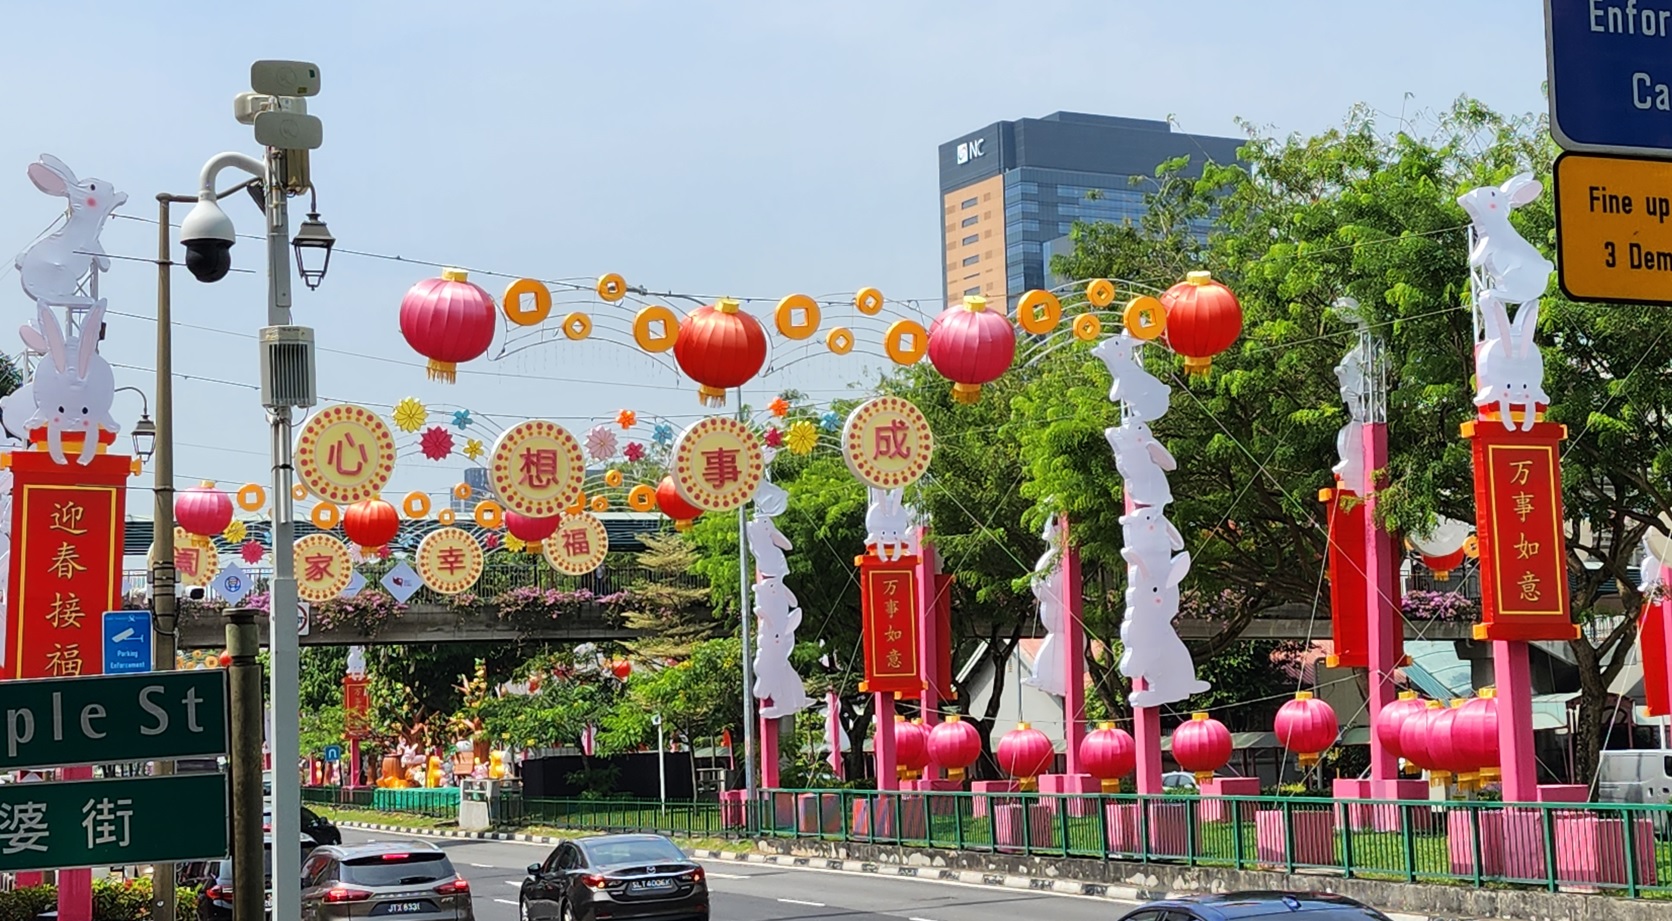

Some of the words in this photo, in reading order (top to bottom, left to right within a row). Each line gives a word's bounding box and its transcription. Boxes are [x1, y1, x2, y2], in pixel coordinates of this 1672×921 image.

[1589, 0, 1671, 37] Enfor
[1632, 72, 1671, 111] Ca
[1589, 186, 1633, 214] Fine
[1645, 196, 1670, 224] up
[1604, 241, 1616, 268] 3
[1629, 242, 1672, 271] Dem
[327, 431, 368, 476] 心
[518, 446, 560, 489] 想
[701, 447, 742, 490] 事
[873, 419, 911, 461] 成
[304, 553, 335, 582] 家
[437, 546, 466, 576] 幸
[561, 527, 590, 558] 福
[1509, 459, 1542, 602] 万事如意
[45, 500, 88, 676] 迎春接福
[883, 579, 902, 668] 万事如意
[110, 661, 145, 669] Enforcement
[117, 650, 139, 659] Parking
[7, 691, 107, 757] ple
[138, 685, 204, 736] St
[0, 797, 134, 854] 婆街
